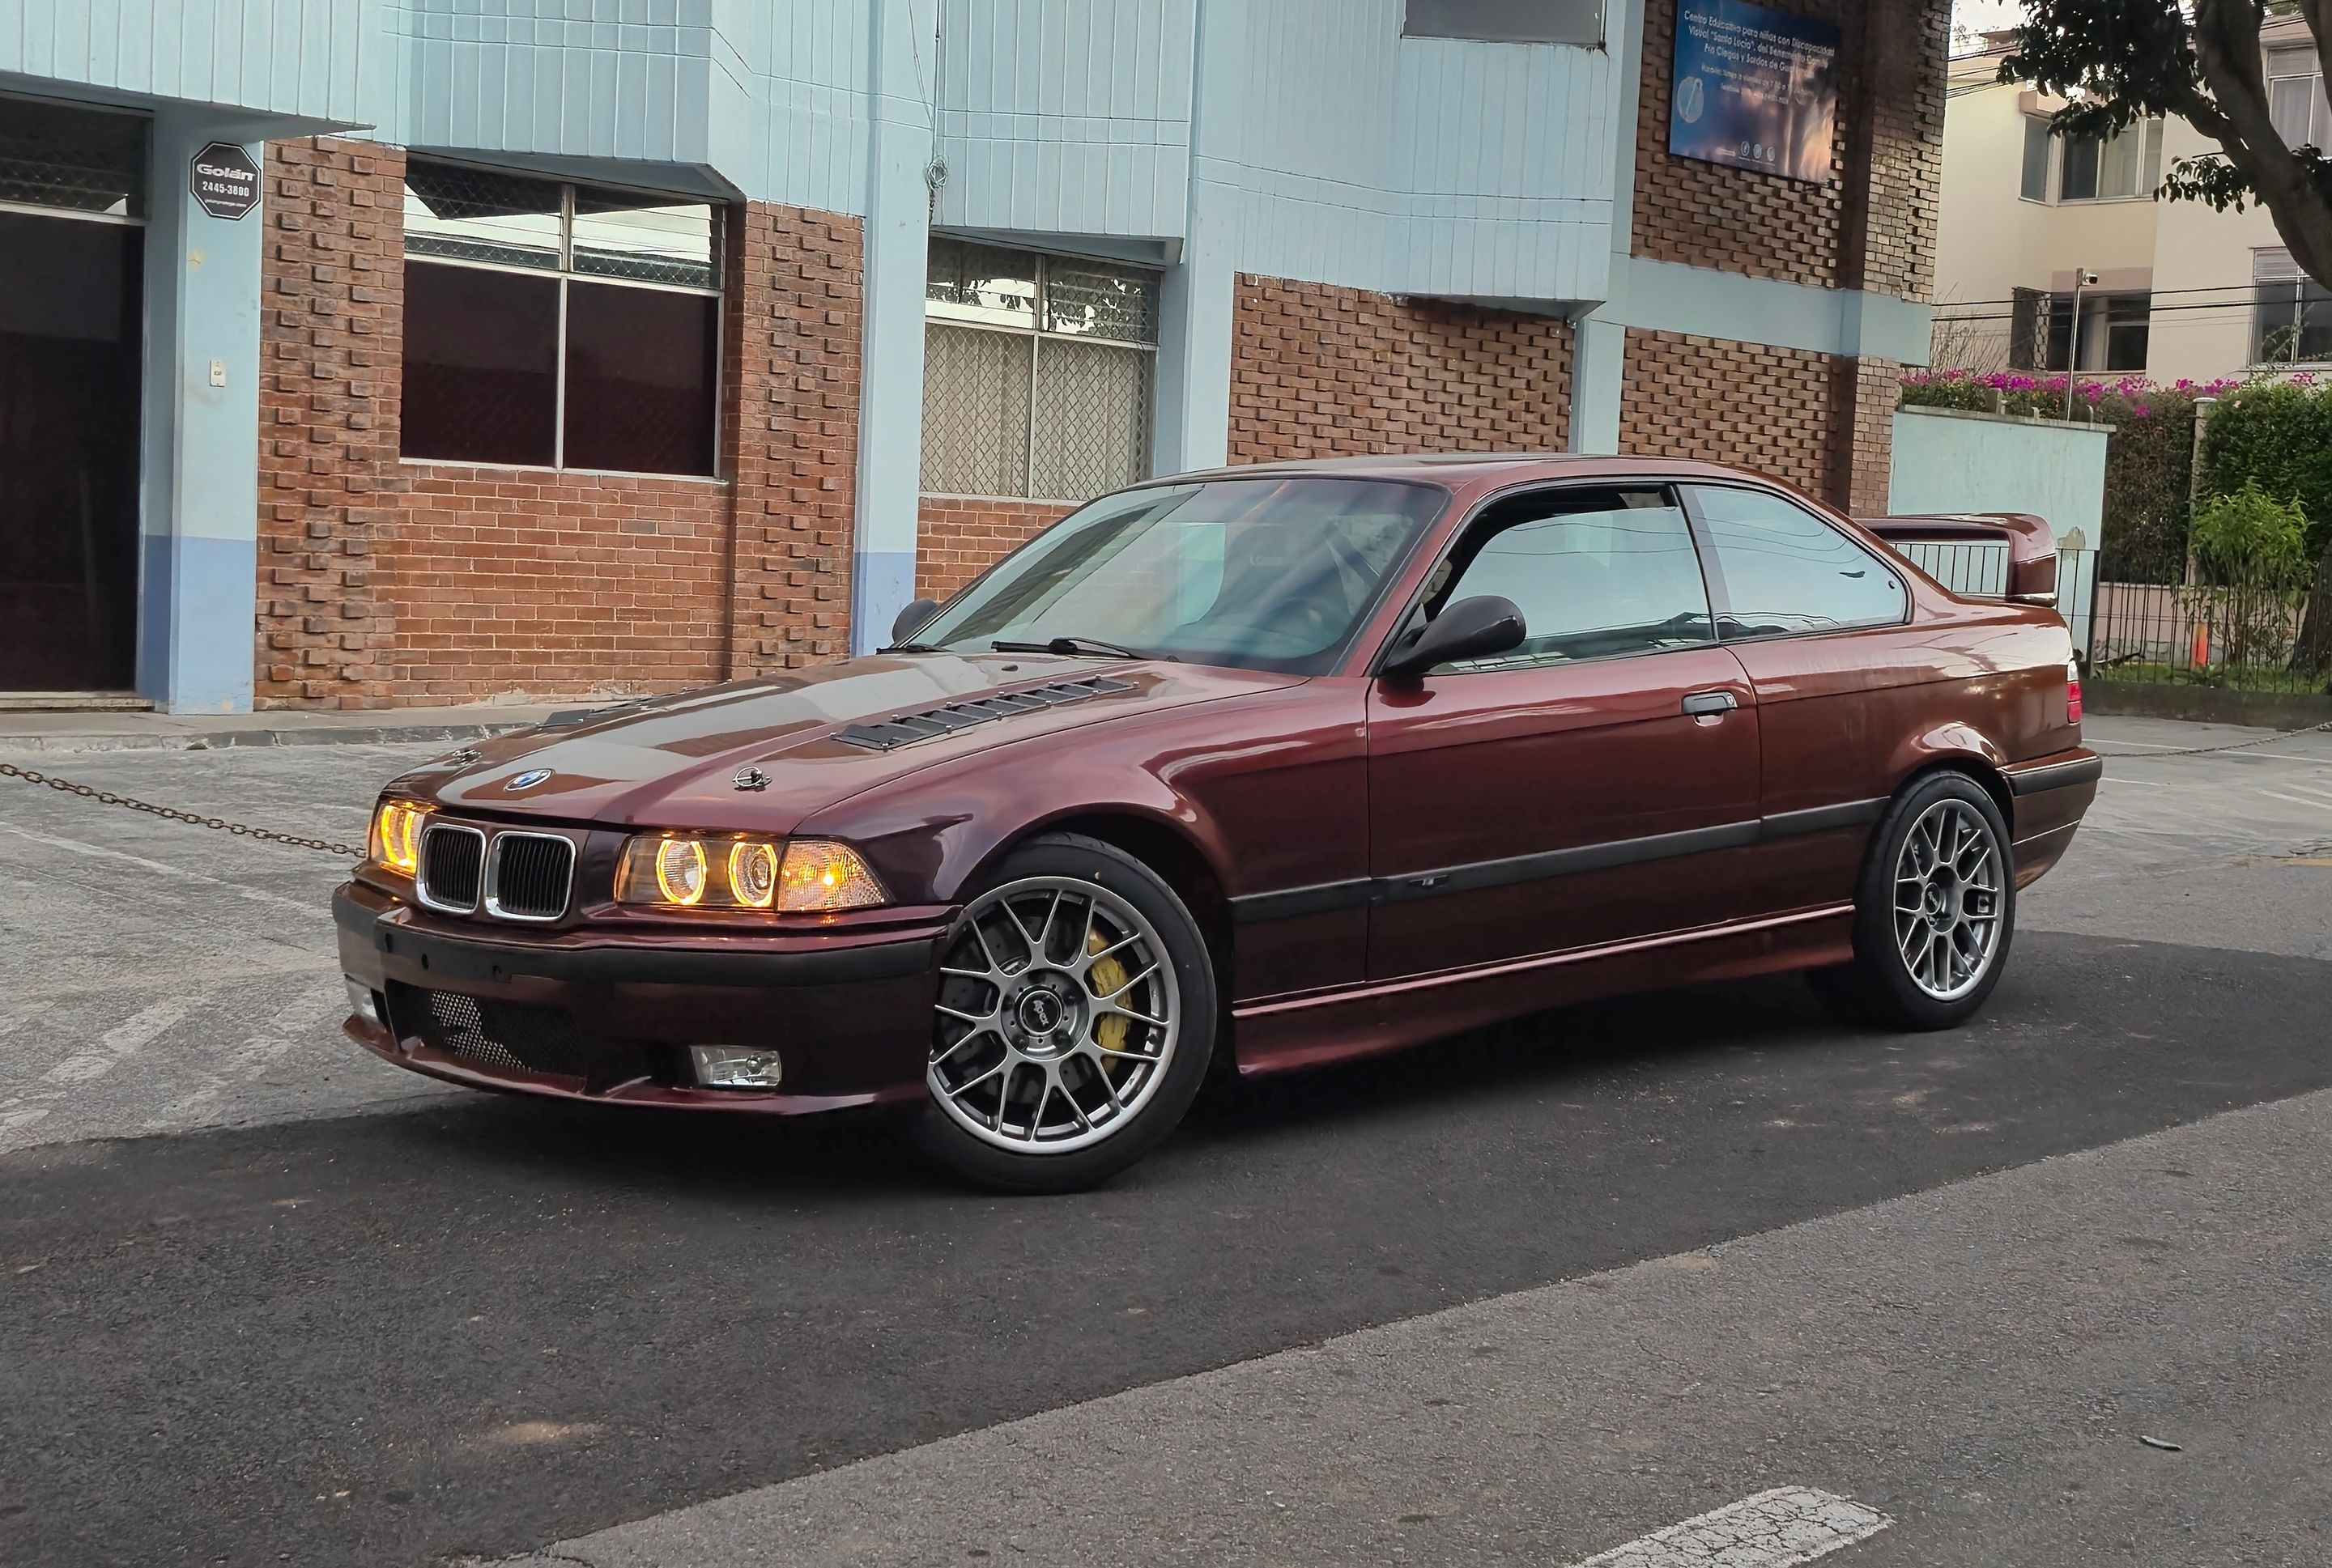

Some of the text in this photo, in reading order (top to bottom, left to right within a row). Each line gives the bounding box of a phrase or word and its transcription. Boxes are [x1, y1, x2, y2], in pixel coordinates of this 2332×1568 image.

[1684, 10, 1708, 25] Centro
[1709, 16, 1742, 33] Educativo
[1742, 27, 1759, 38] para
[1777, 36, 1791, 46] con
[1792, 37, 1835, 57] Discapacidad
[1688, 24, 1710, 40] Visual
[1757, 43, 1769, 54] del
[1740, 52, 1746, 63] y
[1746, 53, 1768, 67] Sordos
[1769, 60, 1779, 70] de
[197, 164, 255, 181] Golán
